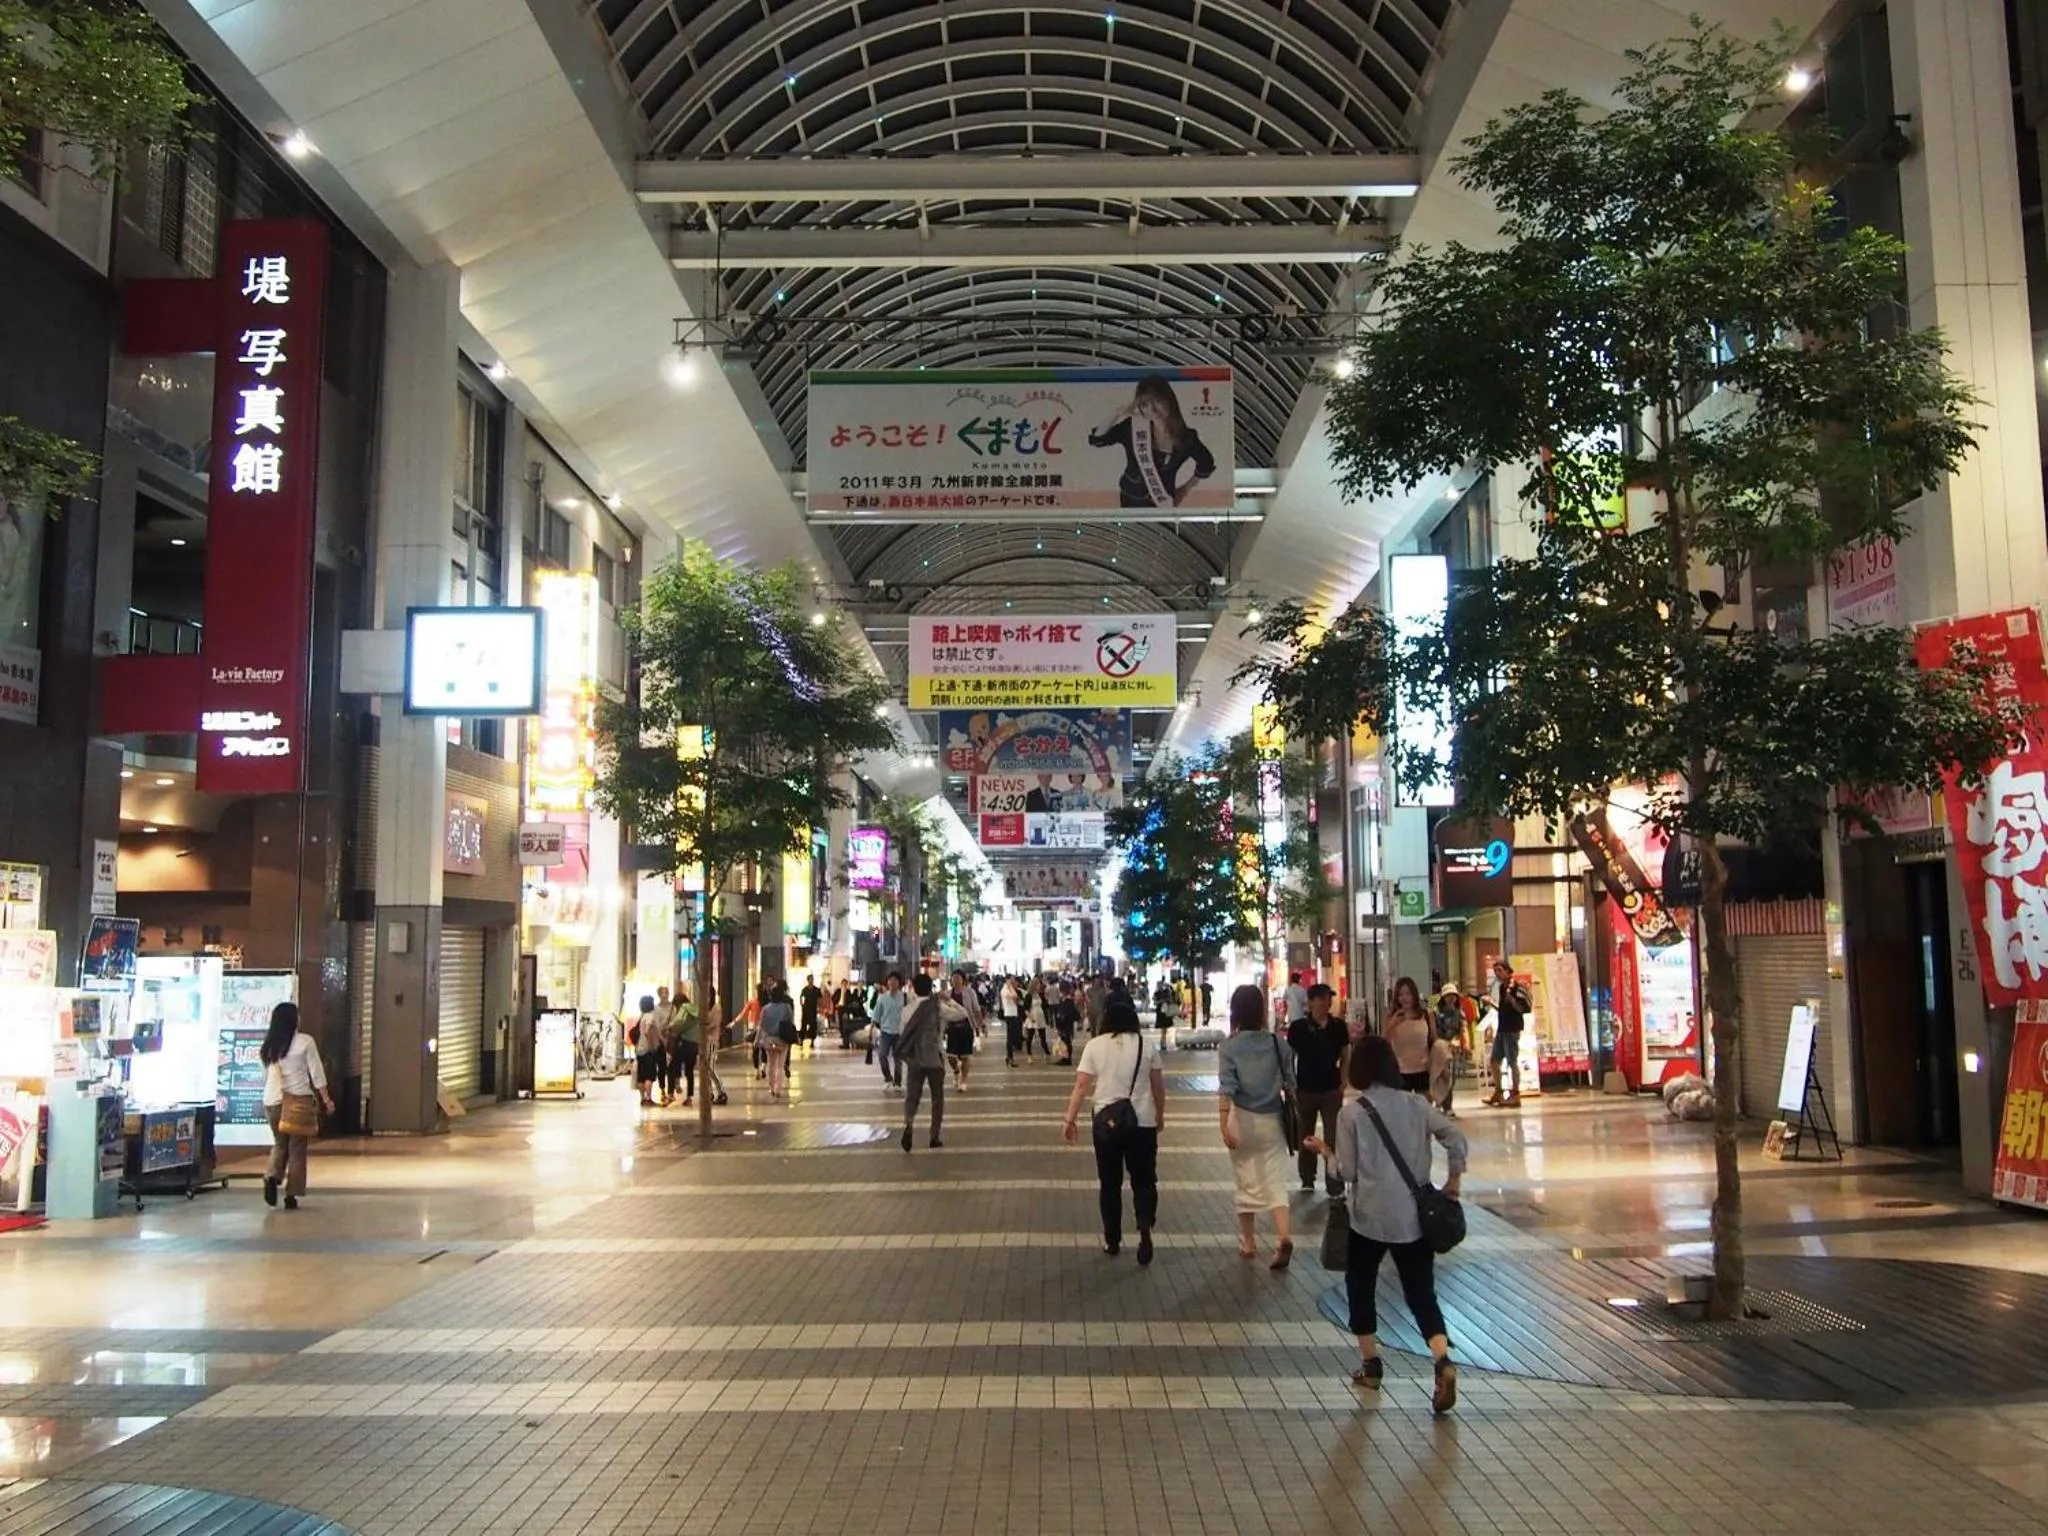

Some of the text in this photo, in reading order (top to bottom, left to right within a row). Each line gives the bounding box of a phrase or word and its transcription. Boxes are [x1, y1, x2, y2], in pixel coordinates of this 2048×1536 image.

[956, 416, 1063, 456] くまもと
[971, 462, 1048, 470] Kumamoto
[839, 476, 922, 489] 2011年3月
[931, 623, 1083, 643] 路上喫煙やポイ捨て
[932, 647, 1005, 661] は禁止です。
[245, 667, 284, 682] Factory
[980, 779, 1026, 792] NEWS
[987, 794, 1026, 812] 4:30
[1484, 839, 1509, 878] 9
